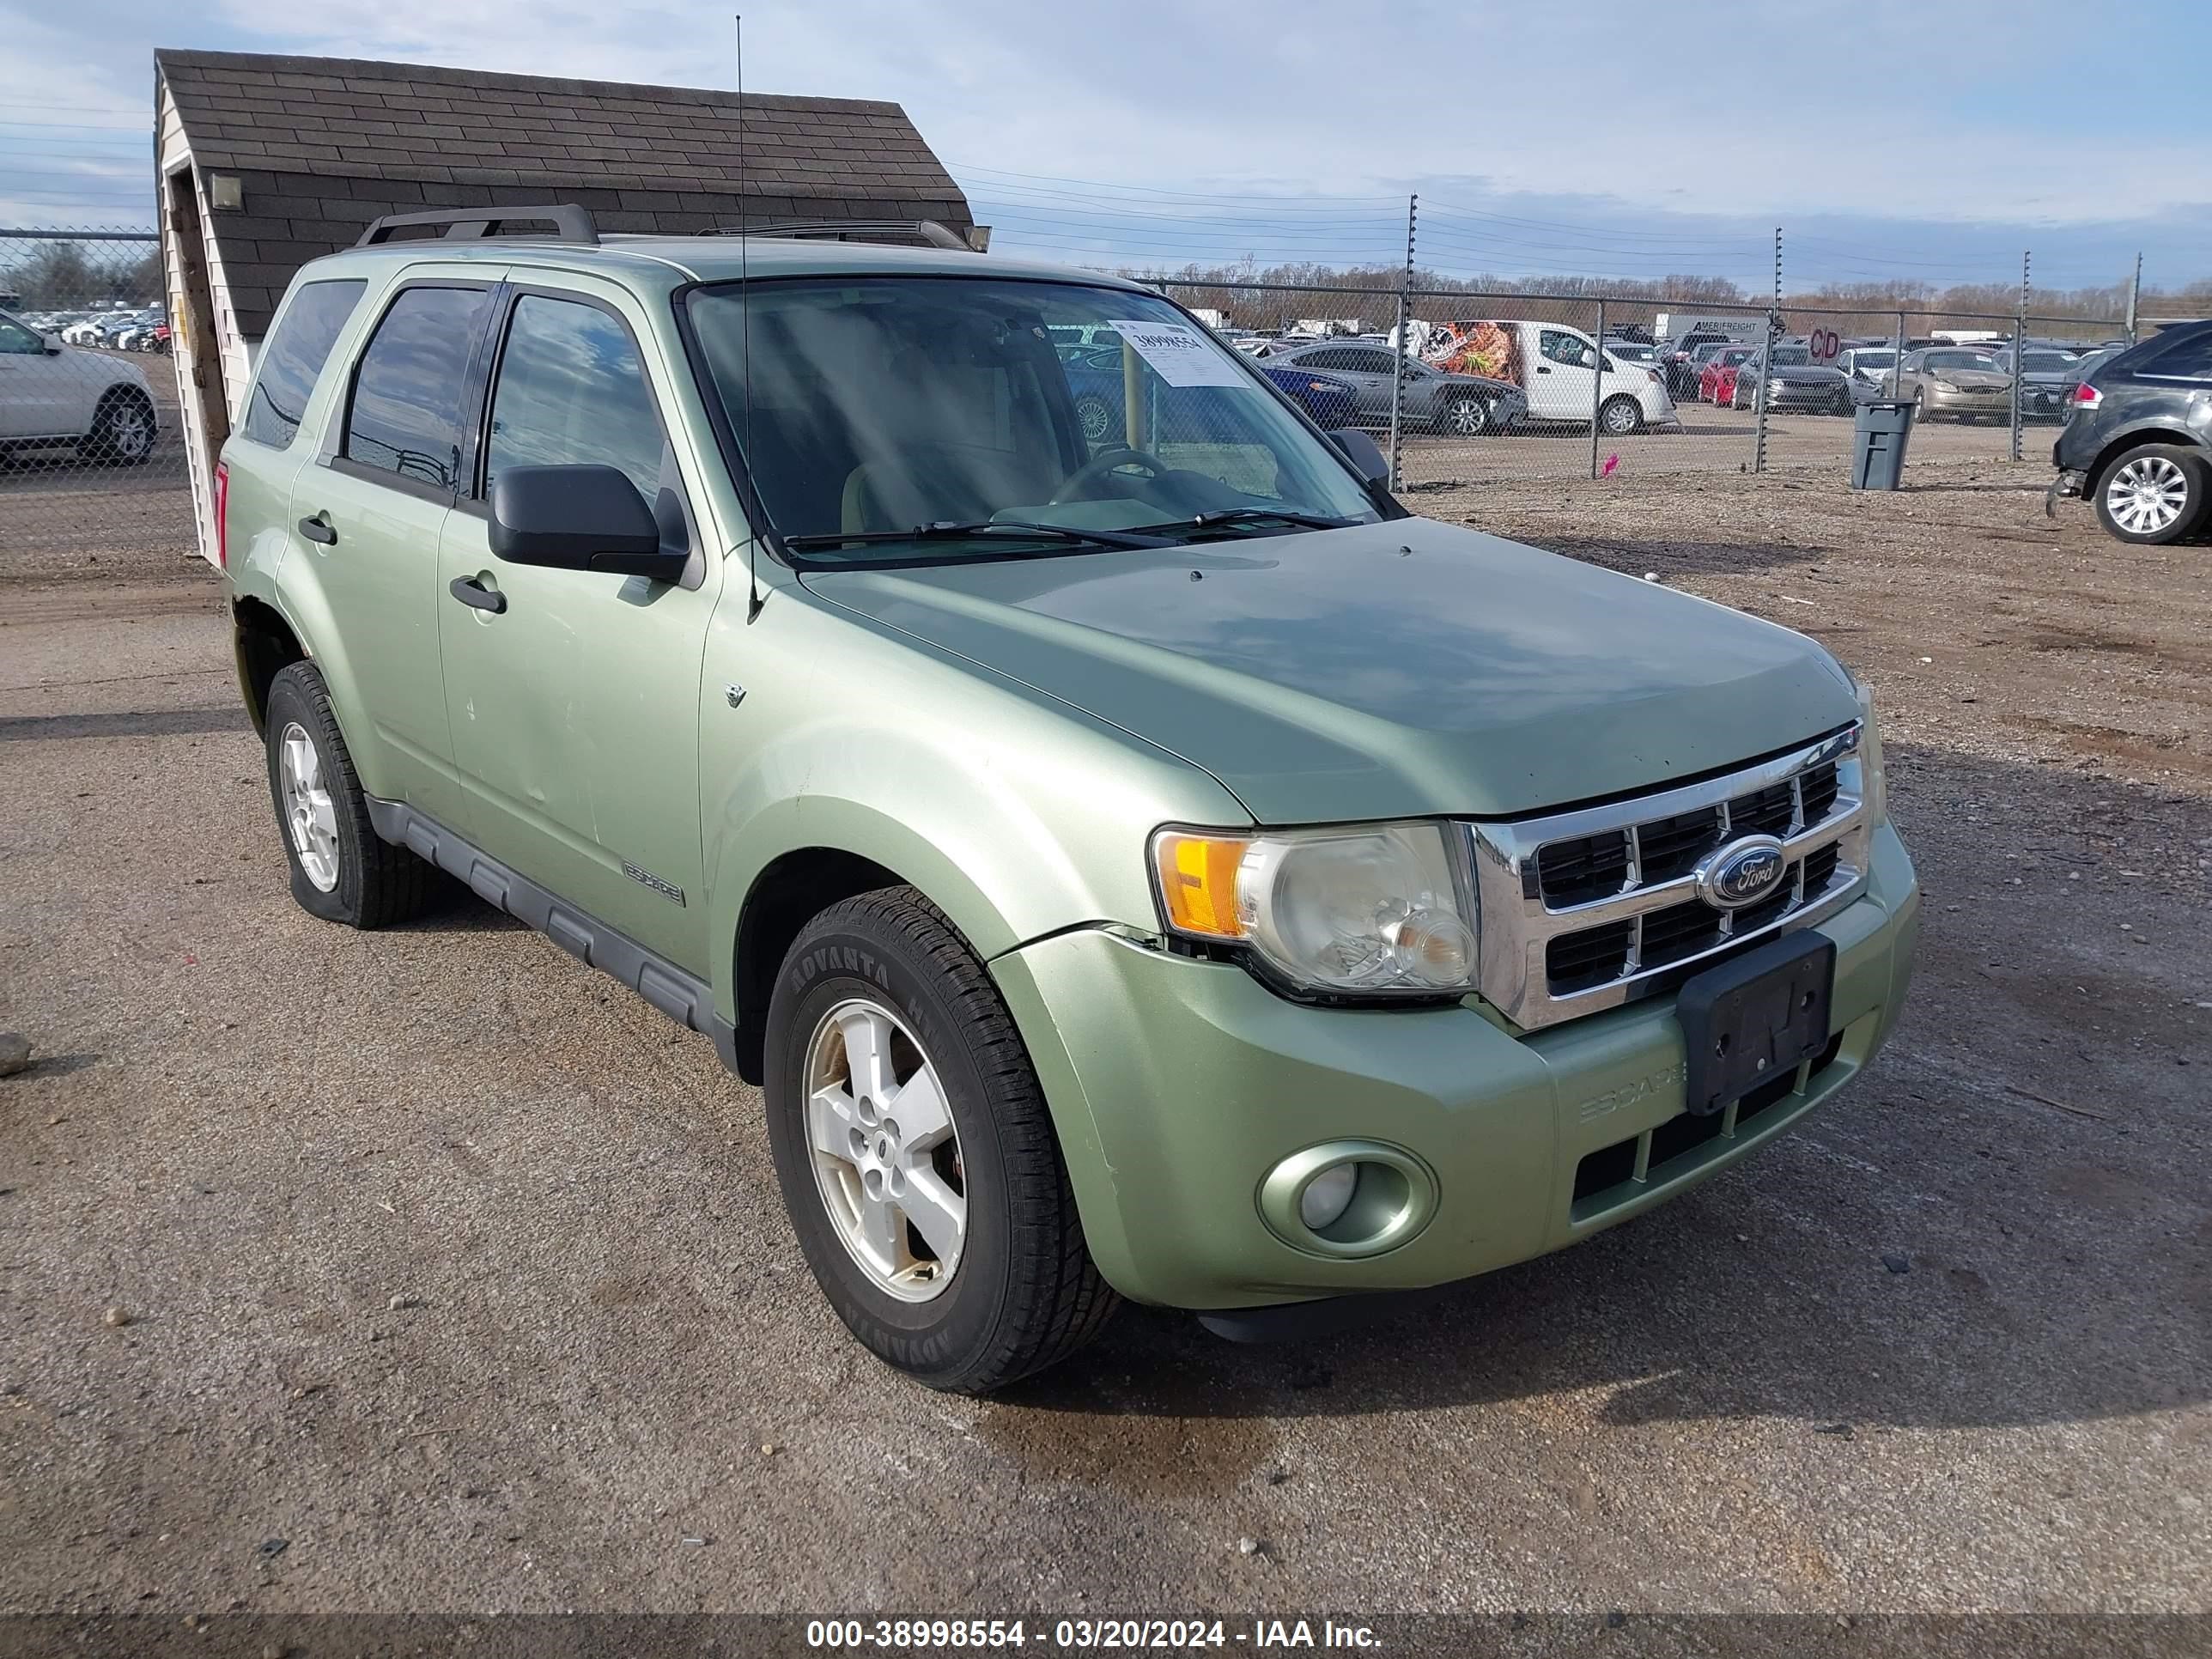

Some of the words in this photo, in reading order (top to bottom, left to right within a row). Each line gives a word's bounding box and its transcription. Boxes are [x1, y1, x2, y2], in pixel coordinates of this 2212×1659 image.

[1133, 334, 1202, 349] 38998554
[1693, 321, 1758, 332] AMERIFREIGHT
[624, 862, 682, 902] ESCAPE
[1738, 856, 1774, 891] Ford
[791, 946, 890, 994] ADVANTA
[1579, 1061, 1686, 1123] ESCAPE
